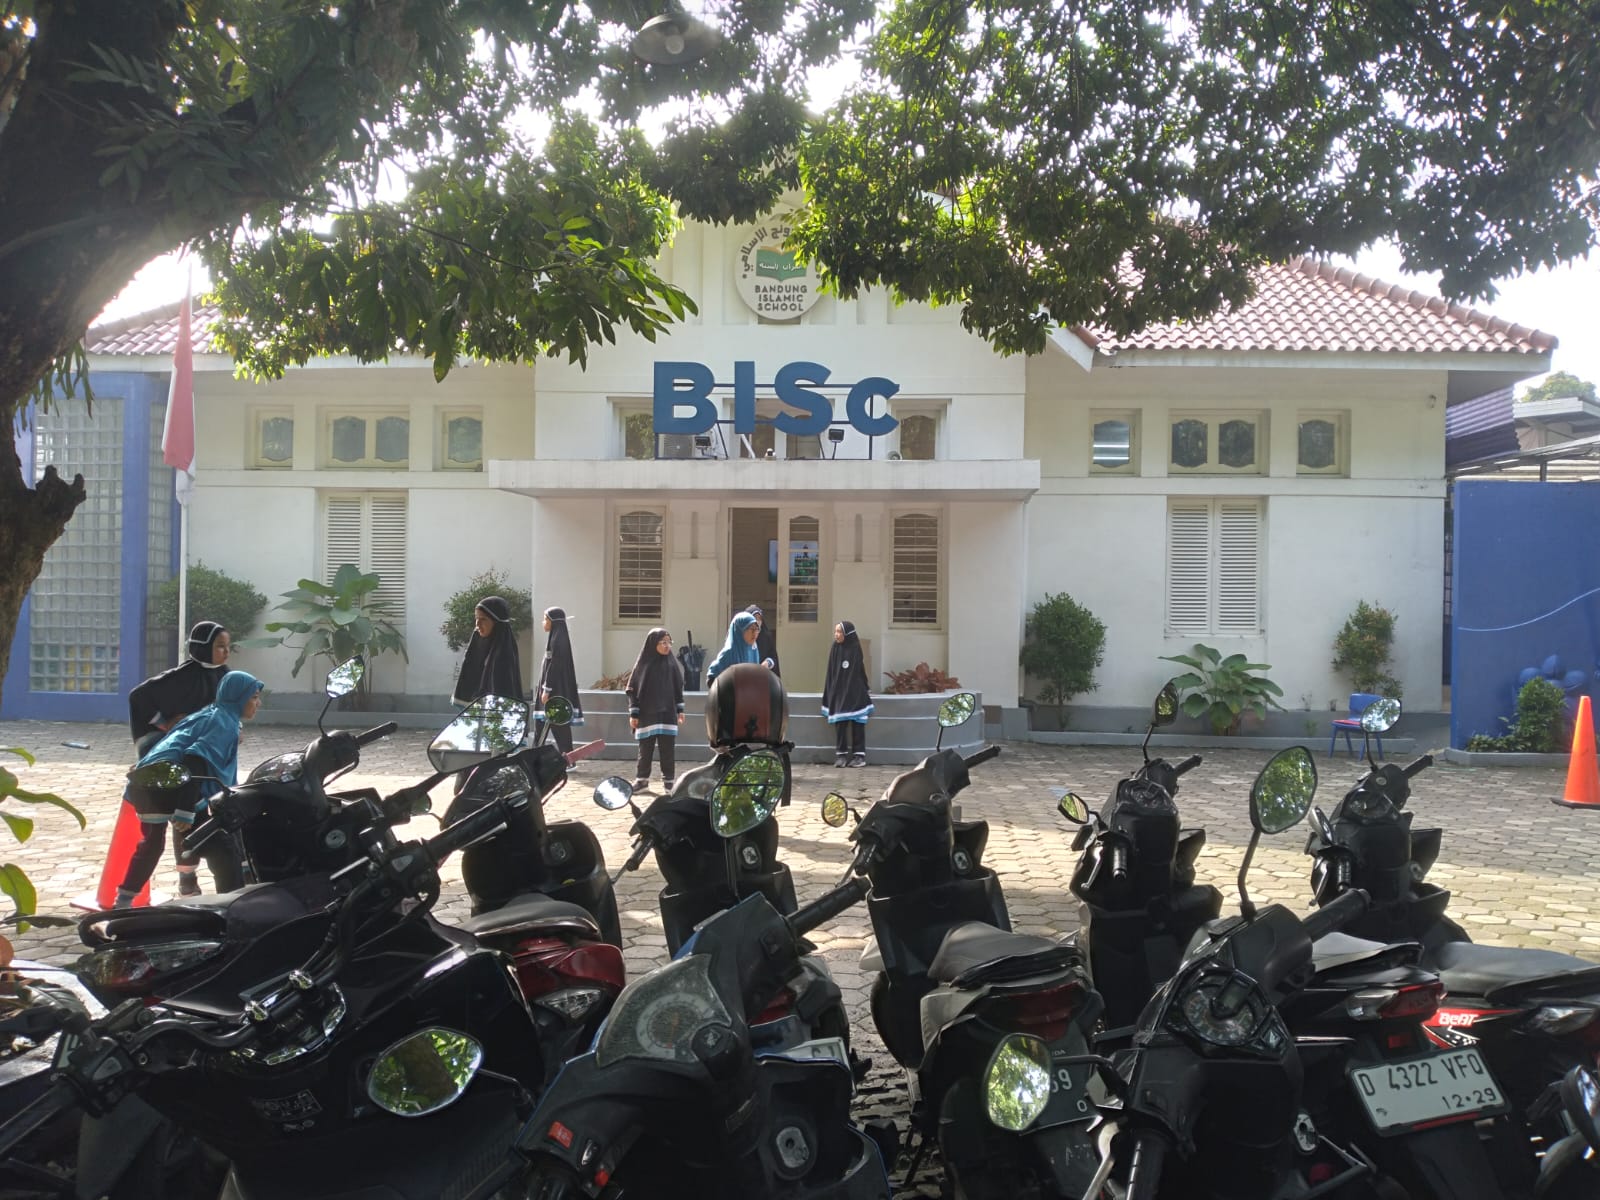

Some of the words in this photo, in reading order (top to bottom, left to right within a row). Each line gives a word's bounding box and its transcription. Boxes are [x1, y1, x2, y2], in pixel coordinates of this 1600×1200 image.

[754, 285, 808, 294] BANDUNG
[758, 294, 804, 302] ISLAMIC
[757, 303, 804, 312] SCHOOL
[1357, 1073, 1376, 1097] D
[1387, 1062, 1438, 1091] 4322
